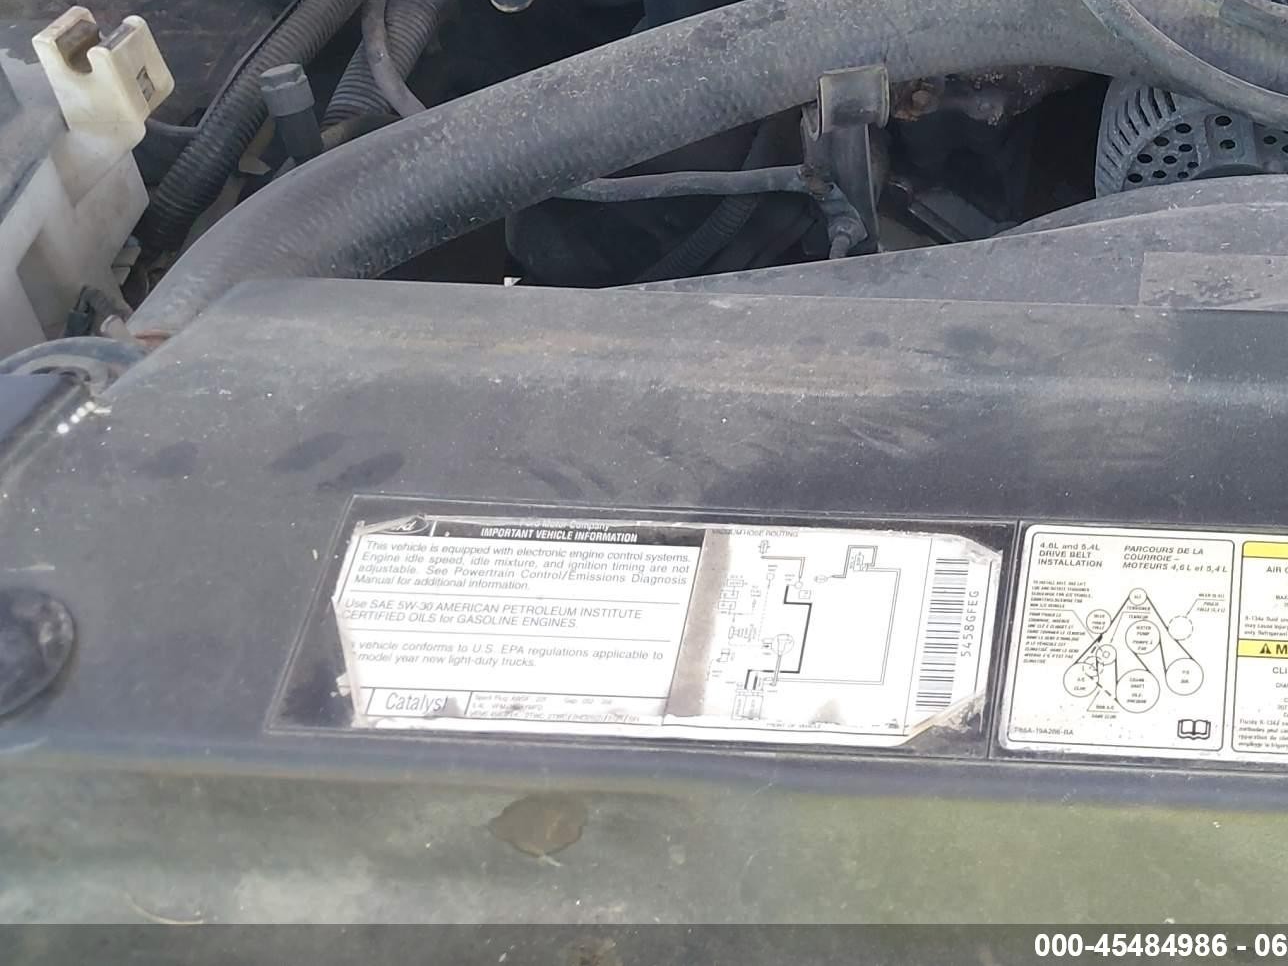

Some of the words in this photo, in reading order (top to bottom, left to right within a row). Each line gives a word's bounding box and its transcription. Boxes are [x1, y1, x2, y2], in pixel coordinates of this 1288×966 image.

[481, 528, 534, 538] IMPORTANT
[536, 529, 573, 540] VEHICLE
[574, 530, 638, 543] INFORMATION
[366, 540, 388, 551] This
[390, 541, 428, 552] vehicle
[430, 543, 439, 553] is
[441, 543, 490, 556] equipped
[494, 545, 514, 555] with
[516, 546, 568, 557] electronic
[568, 548, 605, 561] engine
[607, 549, 644, 560] control
[644, 551, 692, 564] systems.
[1040, 550, 1066, 558] DRIVE
[1124, 545, 1174, 554] PARCOURS
[1124, 553, 1172, 562] COURROIE
[362, 552, 400, 564] Engine
[404, 554, 424, 563] idle
[470, 556, 490, 566] idle
[494, 557, 538, 570] mixture,
[543, 559, 564, 569] and
[568, 560, 608, 572] ignition
[612, 561, 645, 574] timing
[649, 565, 668, 573] are
[672, 564, 690, 573] not
[1038, 558, 1103, 568] INSTALLATION
[1122, 562, 1168, 570] MOTEURS
[1266, 566, 1282, 574] AIR
[354, 573, 396, 584] Manual
[396, 575, 412, 585] for
[414, 576, 466, 587] additional
[425, 566, 448, 576] See
[454, 567, 515, 579] Powertrain
[520, 569, 626, 585] Control/Emissions
[631, 574, 687, 587] Diagnosis
[345, 598, 367, 609] Use
[370, 599, 395, 610] SAE
[396, 600, 434, 612] 5W-30
[436, 601, 500, 614] AMERICAN
[502, 604, 576, 617] PETROLEUM
[580, 607, 644, 620] INSTITUTE
[340, 609, 406, 622] CERTIFIED
[408, 612, 437, 623] OILS
[440, 613, 454, 624] for
[456, 614, 518, 626] GASOLINE
[960, 590, 980, 657] 5458GFEG
[359, 640, 398, 651] vehicle
[402, 642, 452, 653] conforms
[457, 644, 468, 653] to
[500, 645, 524, 655] EPA
[528, 646, 589, 660] regulations
[592, 648, 648, 662] applicable
[653, 651, 664, 660] to
[358, 651, 392, 662] model
[394, 655, 418, 666] year
[422, 656, 446, 664] new
[448, 655, 498, 668] light-duty
